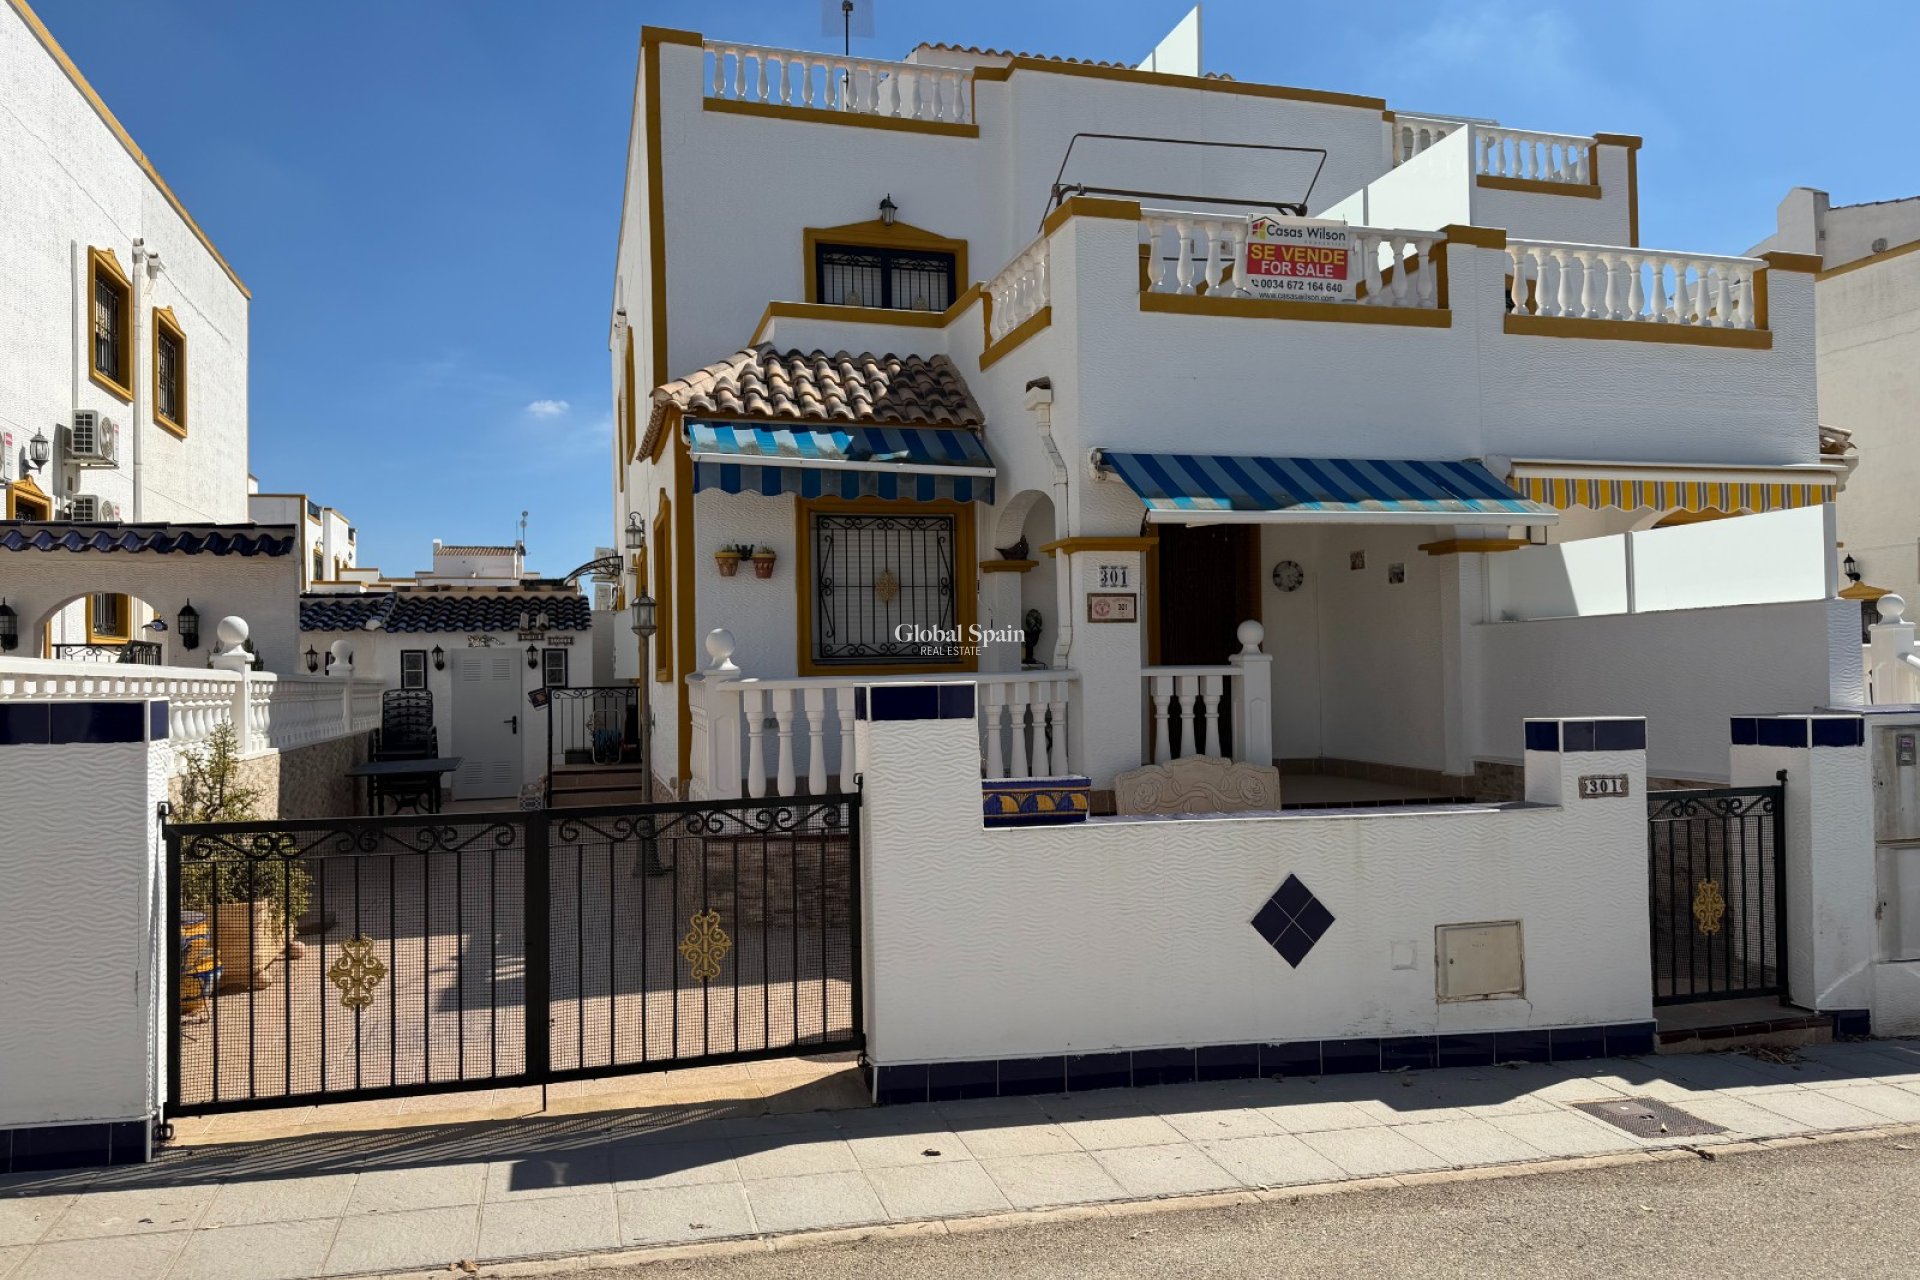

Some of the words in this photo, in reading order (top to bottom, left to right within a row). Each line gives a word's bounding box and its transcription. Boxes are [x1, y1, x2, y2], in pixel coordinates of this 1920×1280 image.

[1266, 224, 1303, 238] Casas
[1306, 227, 1346, 241] Wilson
[1250, 245, 1276, 260] SE
[1281, 246, 1345, 265] VENDE
[1261, 261, 1292, 275] FOR
[1295, 264, 1334, 277] SALE
[1260, 279, 1284, 289] 0034
[1287, 280, 1304, 291] 672
[1308, 281, 1325, 292] 164
[1326, 282, 1343, 293] 640
[1100, 567, 1128, 586] 301
[1589, 780, 1618, 793] 301
